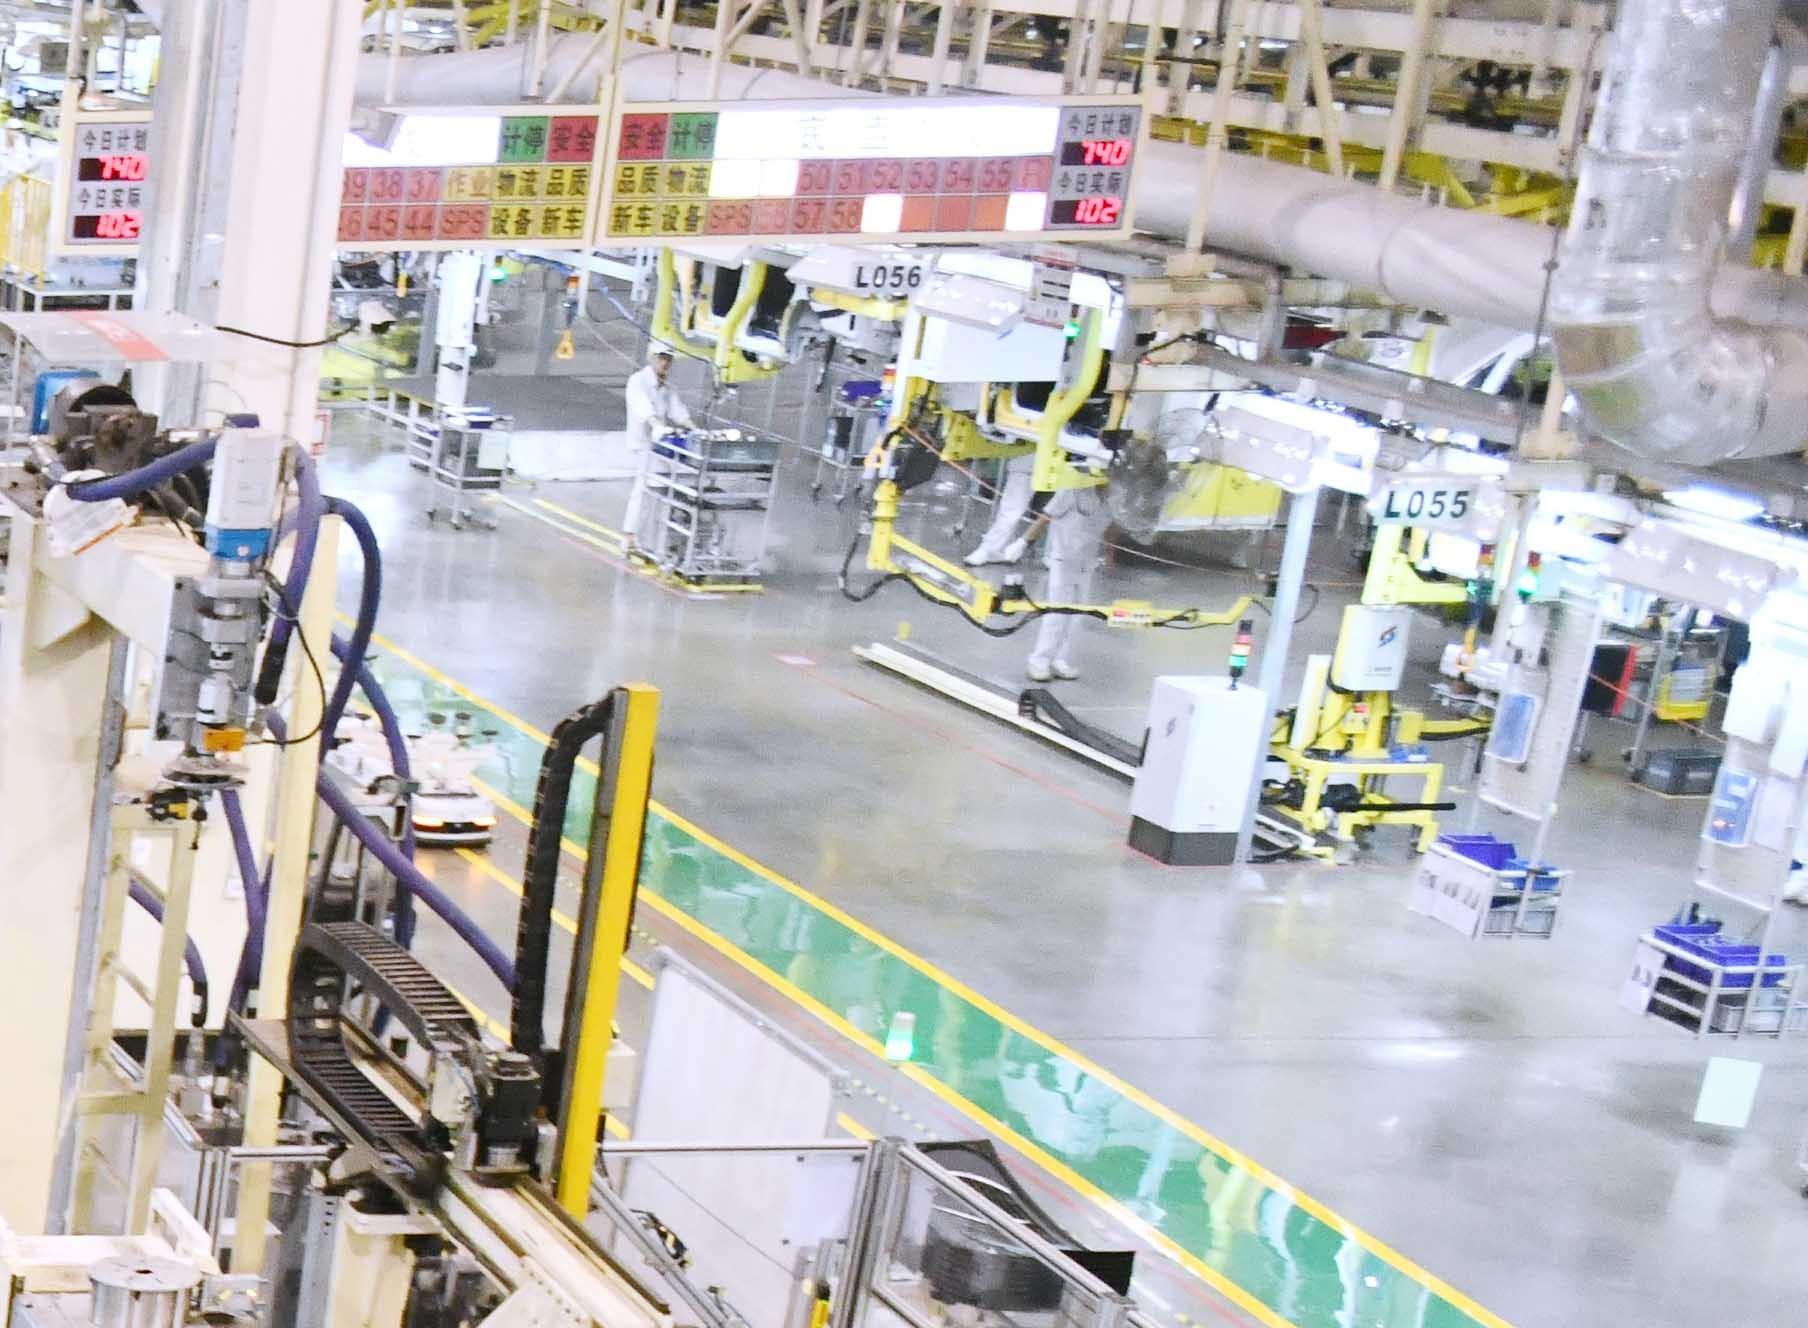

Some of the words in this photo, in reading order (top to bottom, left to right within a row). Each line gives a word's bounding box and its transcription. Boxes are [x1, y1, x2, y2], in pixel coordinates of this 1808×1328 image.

[553, 122, 594, 152] 安全
[624, 122, 666, 150] 安全
[1068, 114, 1132, 136] 今日计划
[1081, 140, 1132, 166] 740
[100, 156, 148, 180] 740
[618, 165, 660, 193] 品质
[668, 165, 709, 193] 物流
[800, 162, 830, 191] 50
[839, 162, 865, 191] 51
[873, 162, 903, 190] 52
[908, 161, 936, 190] 53
[945, 160, 972, 189] 54
[981, 160, 1011, 189] 55
[374, 169, 403, 197] 38
[409, 169, 441, 197] 37
[447, 168, 492, 197] 作业
[496, 168, 536, 197] 物流
[544, 167, 587, 196] 品质
[1058, 171, 1121, 194] 今日实际
[79, 188, 141, 209] 今日实际
[1074, 198, 1123, 224] 102
[96, 213, 140, 238] 102
[367, 208, 399, 236] 45
[404, 208, 433, 236] 44
[441, 208, 485, 235] SPS
[491, 206, 532, 235] 设备
[541, 206, 585, 235] 新车
[612, 204, 653, 233] 新车
[661, 203, 705, 232] 设备
[710, 203, 753, 231] SPS
[793, 201, 826, 230] 57
[830, 201, 861, 230] 58
[856, 265, 921, 288] L056
[1384, 490, 1471, 519] L055
